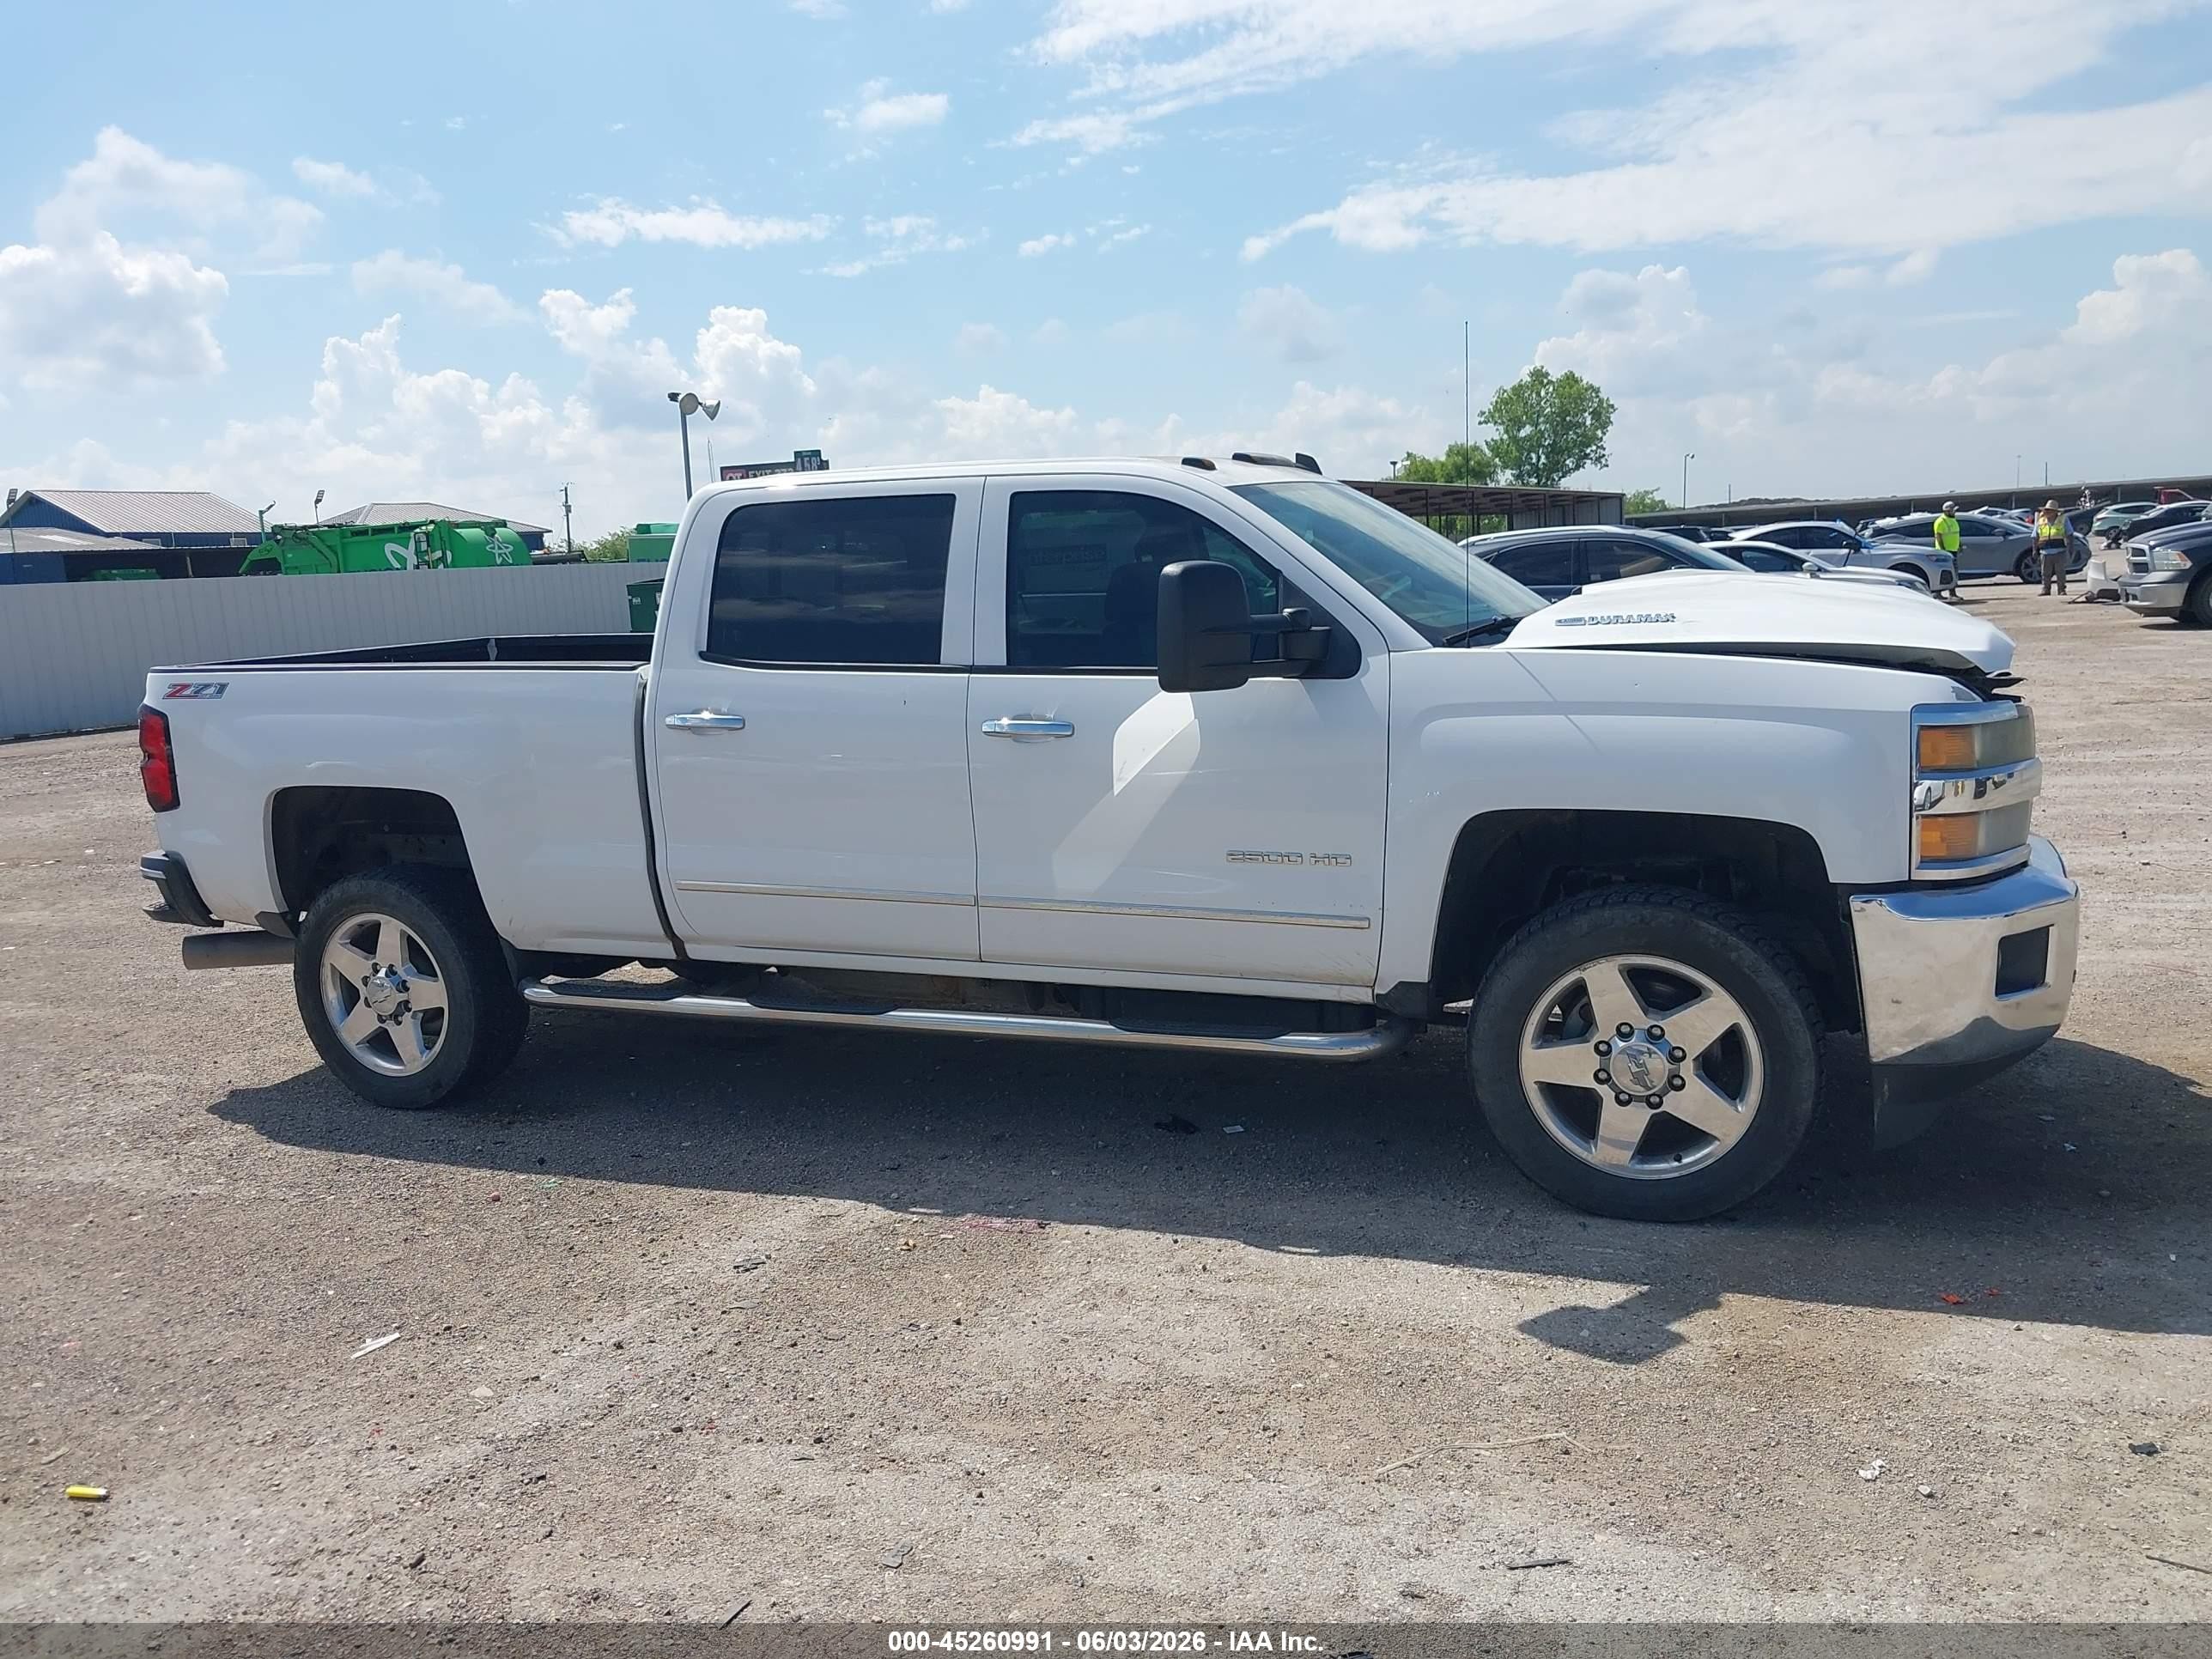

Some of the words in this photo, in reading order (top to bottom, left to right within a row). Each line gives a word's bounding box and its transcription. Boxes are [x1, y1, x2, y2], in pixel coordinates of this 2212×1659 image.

[1587, 613, 1676, 626] DURAMAX
[162, 682, 229, 700] Z71
[1226, 850, 1303, 866] 2500
[1310, 853, 1352, 866] HD
